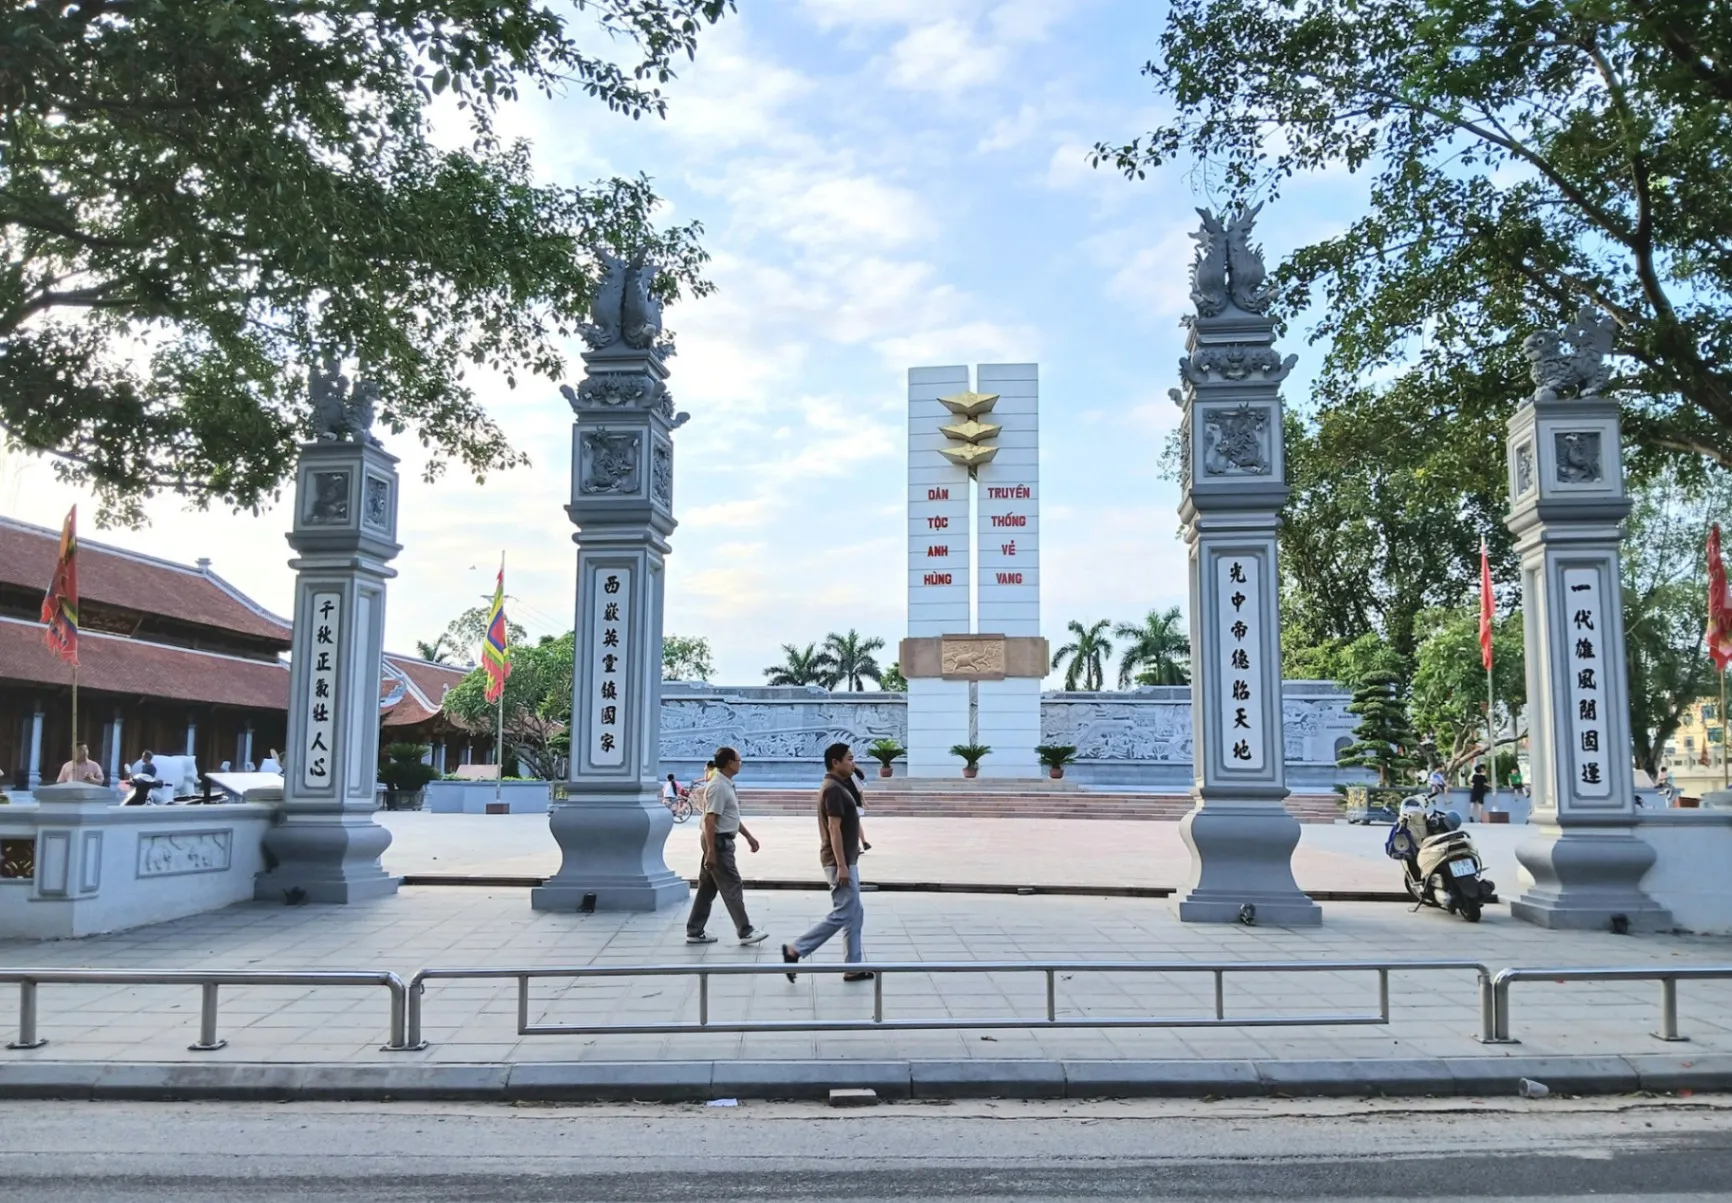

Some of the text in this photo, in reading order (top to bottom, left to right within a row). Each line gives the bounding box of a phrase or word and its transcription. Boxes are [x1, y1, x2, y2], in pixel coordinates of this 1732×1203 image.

[927, 515, 949, 531] TỘC
[991, 512, 1026, 527] THỐNG
[927, 545, 949, 557] ANH
[1001, 540, 1016, 556] VẺ
[924, 571, 952, 585] HÙNG
[996, 573, 1023, 584] VANG
